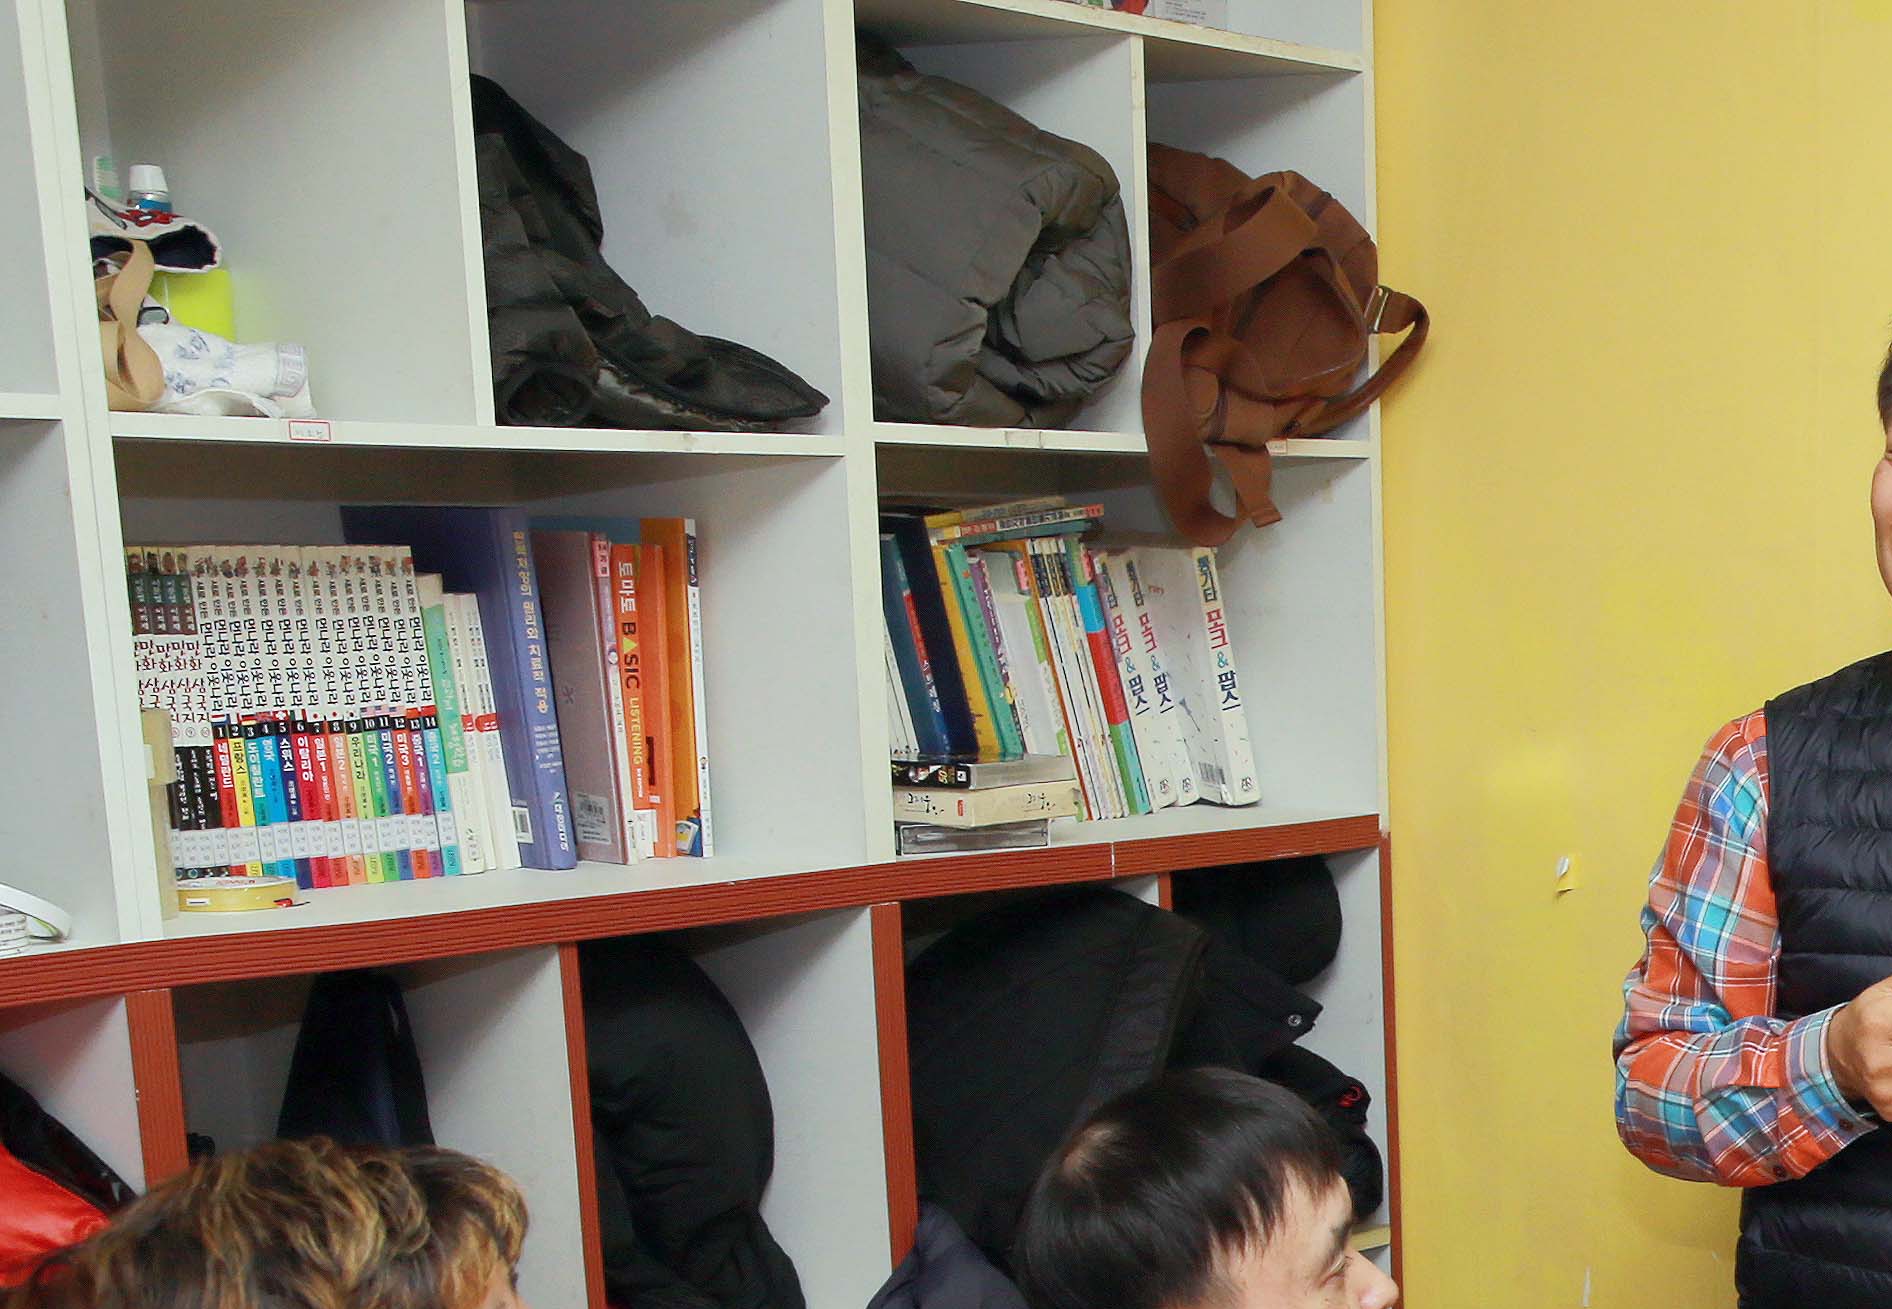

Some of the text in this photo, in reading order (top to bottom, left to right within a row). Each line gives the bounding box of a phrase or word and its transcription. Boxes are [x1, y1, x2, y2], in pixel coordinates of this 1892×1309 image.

[200, 622, 216, 658] 먼나라
[214, 619, 230, 656] 먼나라
[230, 620, 245, 656] 먼나라
[244, 618, 260, 654] 먼나라
[262, 619, 278, 655] 먼나라
[279, 618, 294, 655] 먼나라
[296, 618, 312, 654] 먼나라
[316, 618, 331, 653] 먼나라
[363, 616, 378, 650] 먼나라
[378, 617, 394, 652] 먼나라
[394, 618, 410, 654] 먼나라
[410, 617, 425, 651] 먼나라
[1112, 613, 1133, 655] 포크
[1138, 612, 1158, 654] 포크
[1206, 608, 1228, 650] 포크
[332, 620, 348, 655] 먼나라
[340, 658, 356, 706] 이웃나라
[348, 617, 364, 652] 먼나라
[356, 656, 371, 703] 이웃나라
[370, 654, 386, 701] 이웃나라
[416, 654, 432, 702] 이웃나라
[619, 562, 636, 613] 토마토
[628, 697, 642, 765] LISTENING
[1124, 656, 1136, 674] &
[1150, 655, 1161, 672] &
[1216, 650, 1230, 670] &
[206, 662, 223, 712] 이웃나라
[221, 659, 238, 708] 이웃나라
[236, 660, 253, 710] 이웃나라
[251, 658, 268, 708] 이웃나라
[268, 659, 285, 708] 이웃나라
[286, 658, 302, 707] 이웃나라
[303, 658, 319, 706] 이웃나라
[322, 657, 338, 704] 이웃나라
[384, 656, 401, 702] 이웃나라
[400, 657, 416, 704] 이웃나라
[1128, 674, 1150, 716] 팝스
[1153, 672, 1175, 714] 팝스
[1217, 670, 1242, 712] 팝스
[218, 728, 226, 736] 1
[232, 726, 240, 736] 2
[280, 723, 286, 733] 5
[297, 722, 304, 732] 6
[332, 722, 341, 731] 8
[350, 721, 358, 731] 9
[364, 719, 375, 730] 10
[378, 716, 390, 727] 11
[424, 716, 436, 726] 14
[280, 738, 294, 772] 스위스
[298, 736, 314, 782] 이탈리아
[351, 736, 365, 780] 우리나라
